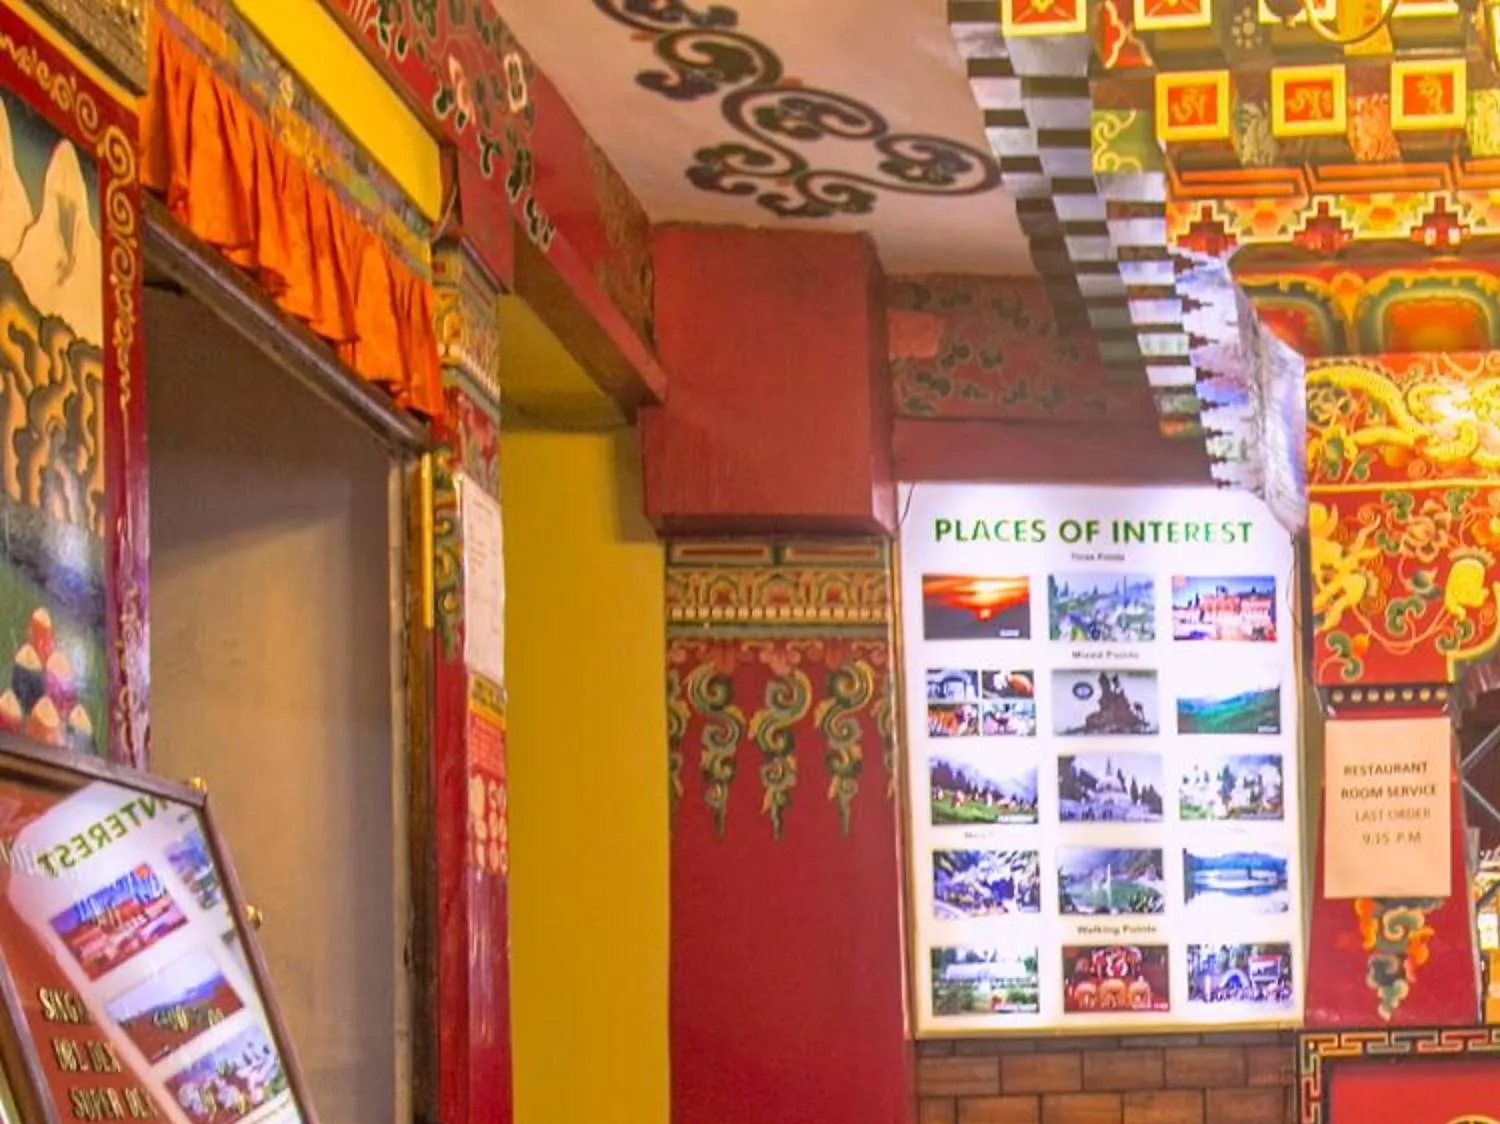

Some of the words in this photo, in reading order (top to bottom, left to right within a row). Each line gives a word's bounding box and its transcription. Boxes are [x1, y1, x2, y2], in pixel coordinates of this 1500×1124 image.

[934, 518, 1046, 544] PLACES
[1059, 518, 1100, 544] OF
[1113, 519, 1254, 544] INTEREST
[1343, 761, 1429, 776] RESTAURANT
[1341, 787, 1384, 800] ROOM
[1387, 784, 1437, 797] SERVICE
[1355, 809, 1384, 822] LAST
[1387, 807, 1431, 820] ORDER
[1077, 924, 1120, 937] Walking
[38, 987, 96, 1024] SING
